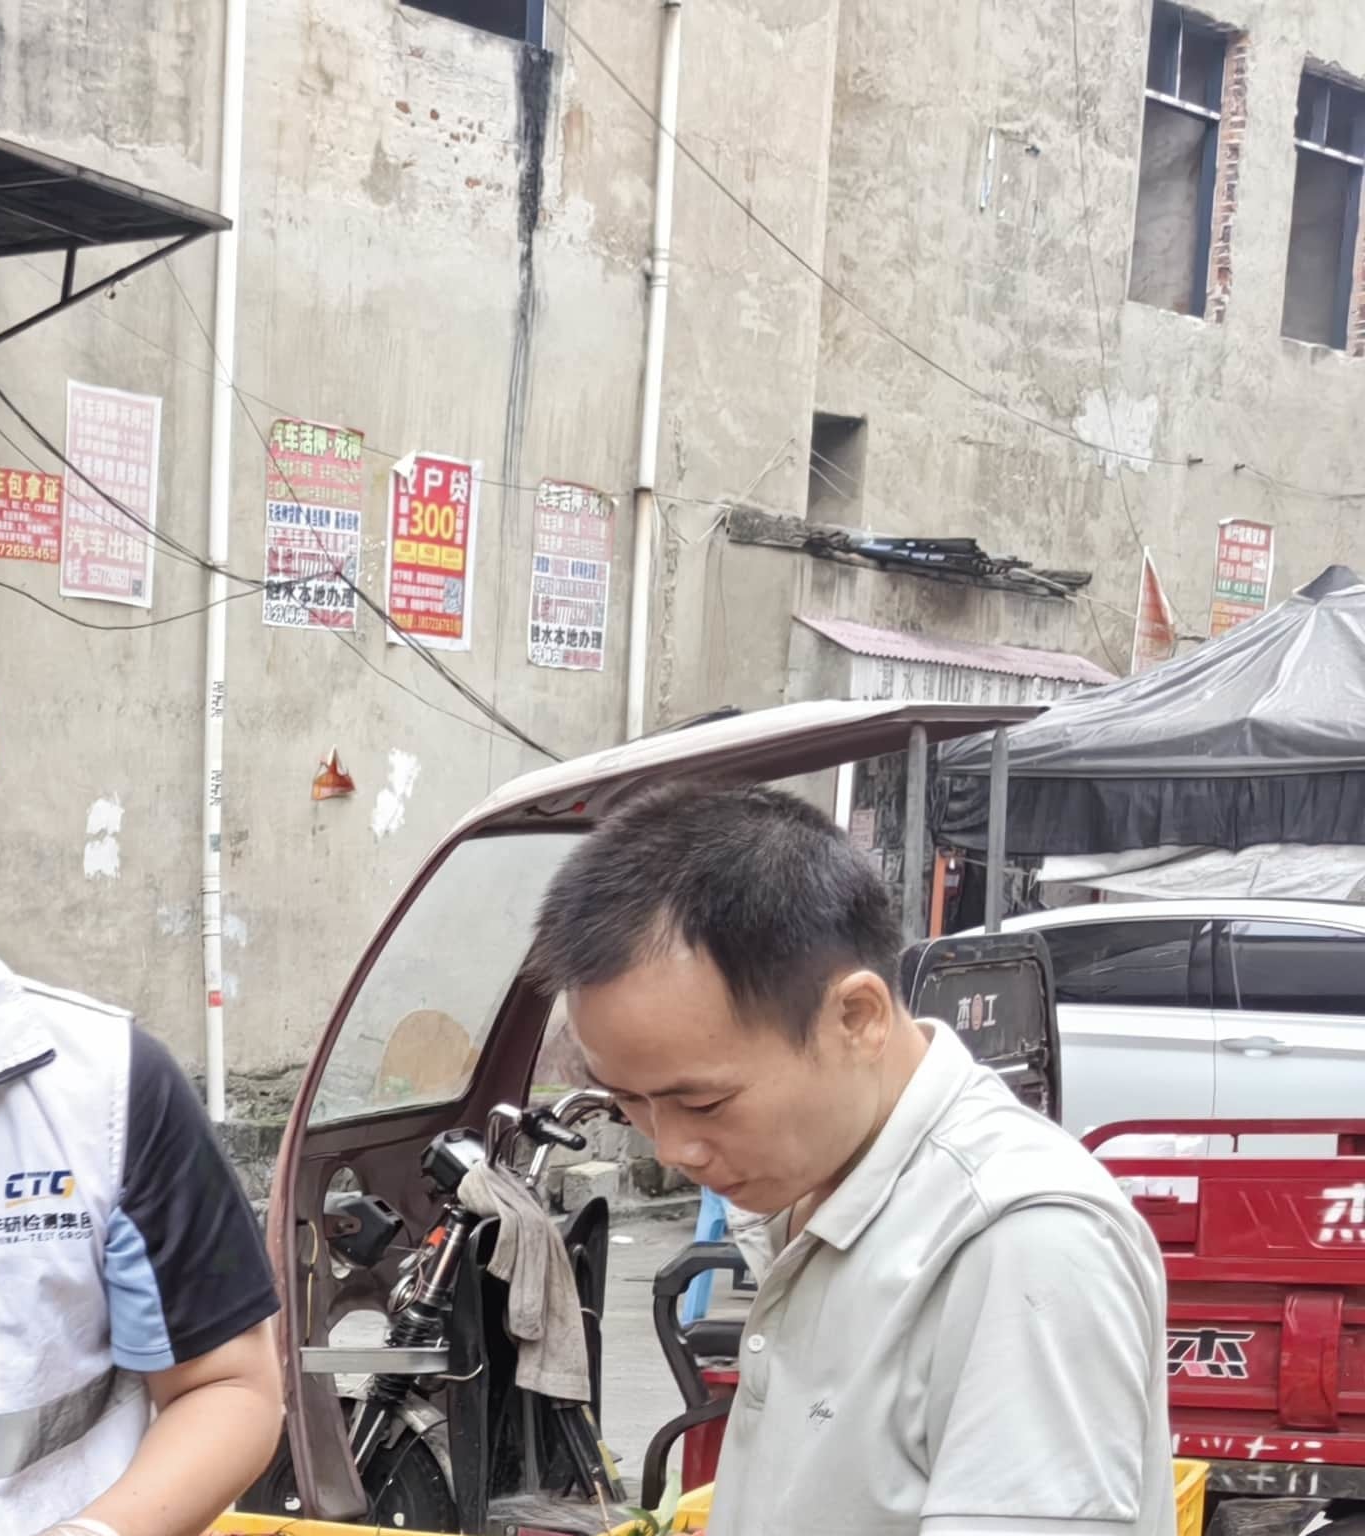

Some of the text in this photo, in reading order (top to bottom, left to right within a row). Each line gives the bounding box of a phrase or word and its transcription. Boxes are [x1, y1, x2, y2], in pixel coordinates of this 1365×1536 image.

[410, 500, 455, 541] 300
[67, 527, 145, 563] 汽车出租
